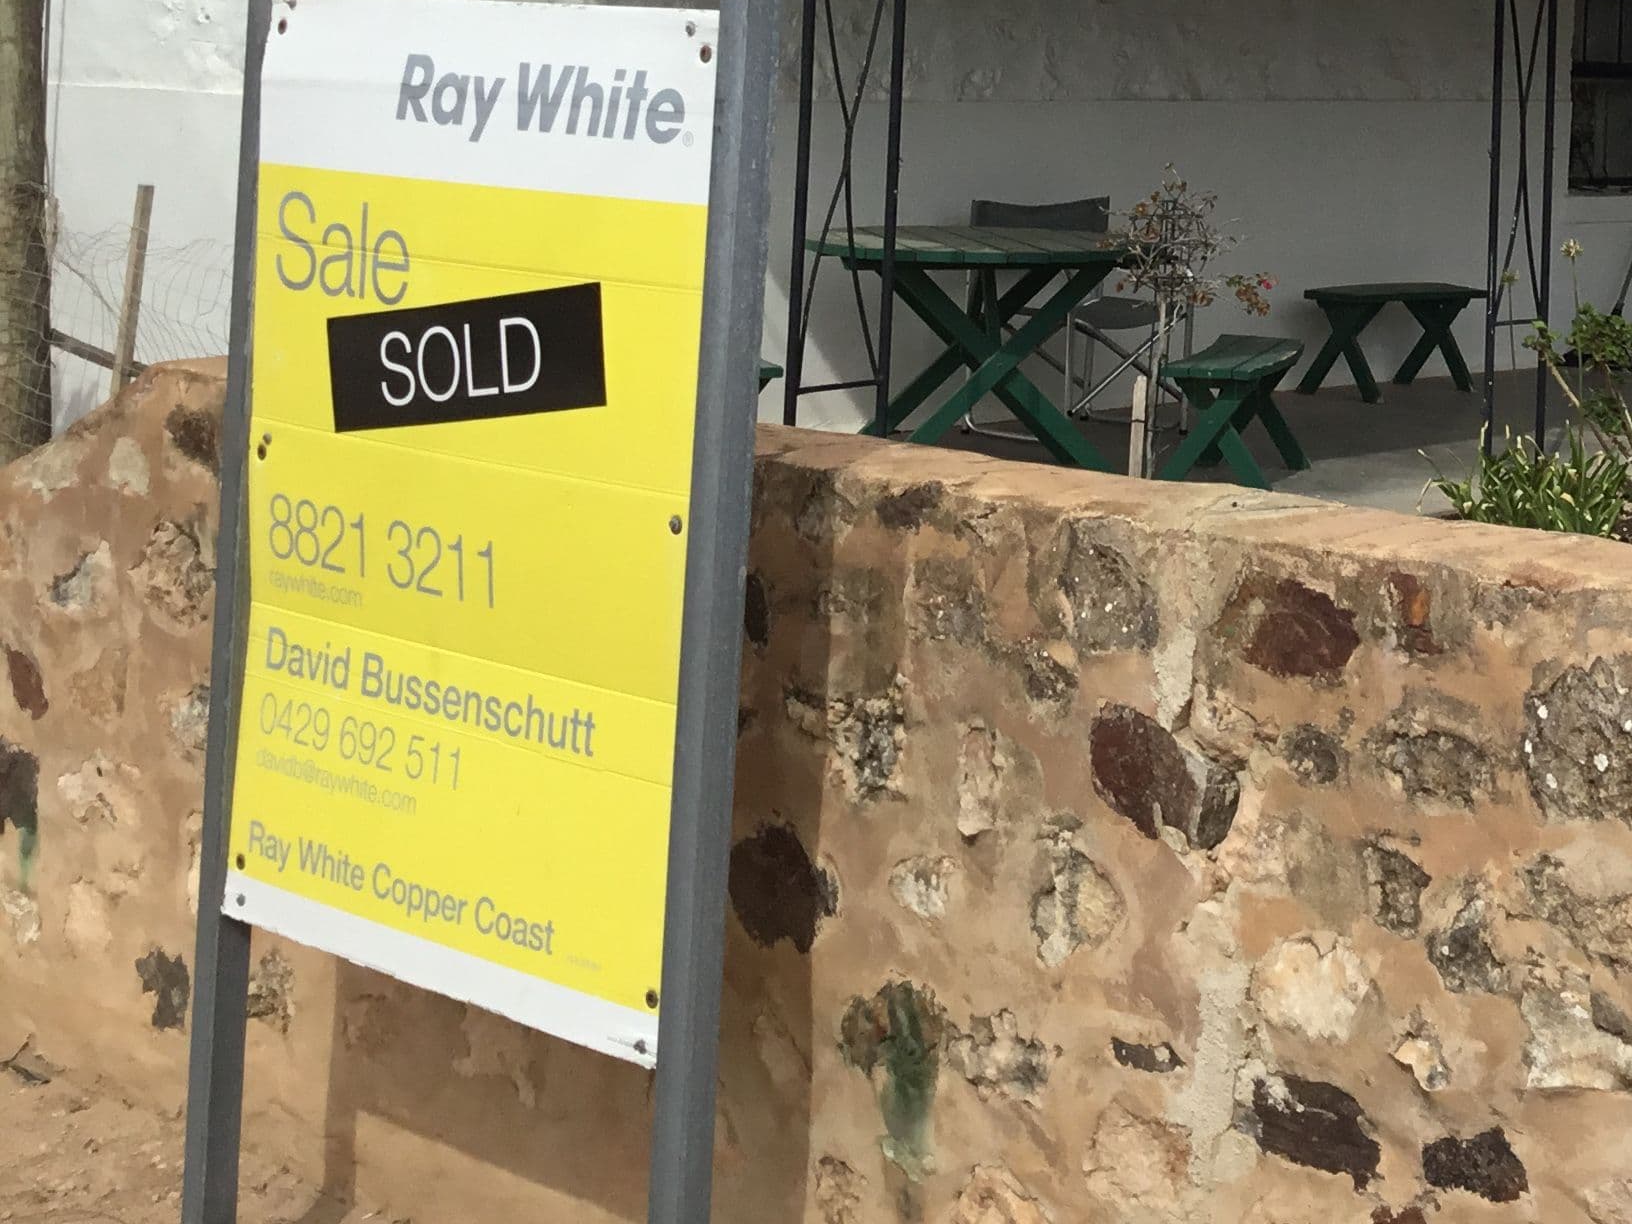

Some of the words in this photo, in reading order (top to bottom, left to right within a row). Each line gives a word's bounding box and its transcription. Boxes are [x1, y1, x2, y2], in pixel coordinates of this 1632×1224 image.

[395, 53, 506, 142] Ray
[516, 62, 686, 145] White
[276, 191, 410, 305] Sale
[380, 316, 541, 406] SOLD
[268, 568, 362, 607] raywhite.com
[269, 493, 365, 578] 8821
[387, 519, 494, 608] 3211
[259, 692, 330, 751] 0429
[339, 716, 395, 772] 692
[405, 735, 460, 791] 511
[266, 626, 351, 690] David
[361, 651, 596, 757] Bussenschutt
[249, 820, 291, 873] Ray
[298, 836, 365, 891] White
[371, 862, 468, 924] Copper
[474, 896, 555, 955] Coast
